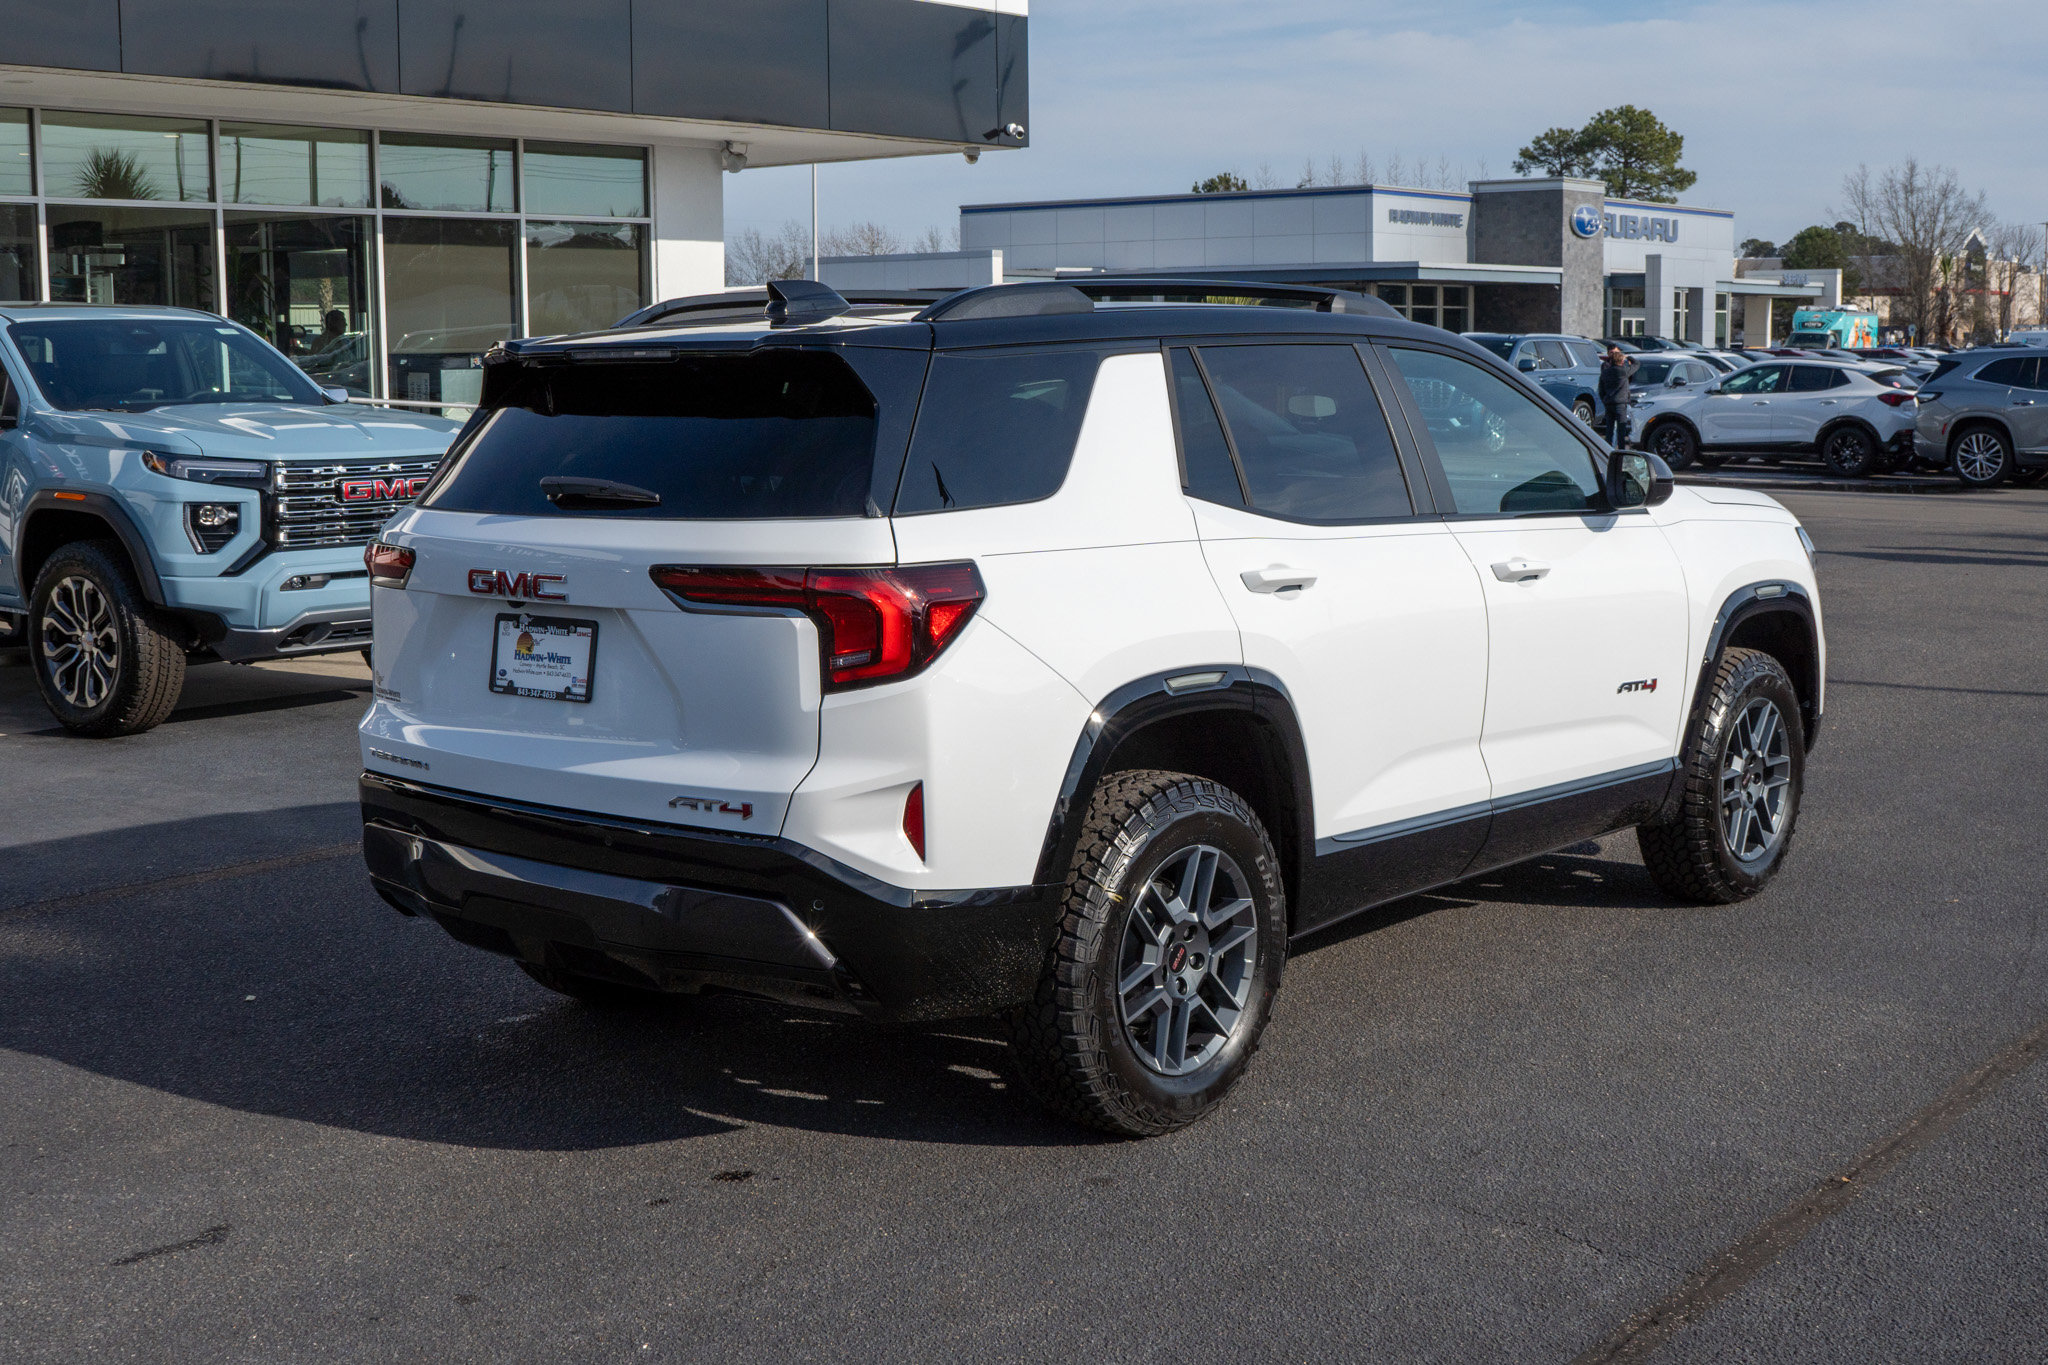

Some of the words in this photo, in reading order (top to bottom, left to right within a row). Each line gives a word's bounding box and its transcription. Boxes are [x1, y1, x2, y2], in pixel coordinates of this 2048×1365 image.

[1602, 213, 1679, 243] SUBARU
[343, 477, 430, 502] GMC
[467, 568, 569, 603] GMC
[519, 624, 570, 637] HADWIN-WHITE
[514, 650, 572, 665] HADWIN-WHITE
[517, 687, 557, 699] 843-347-4633
[1617, 678, 1658, 695] AT4
[668, 795, 753, 821] AT4
